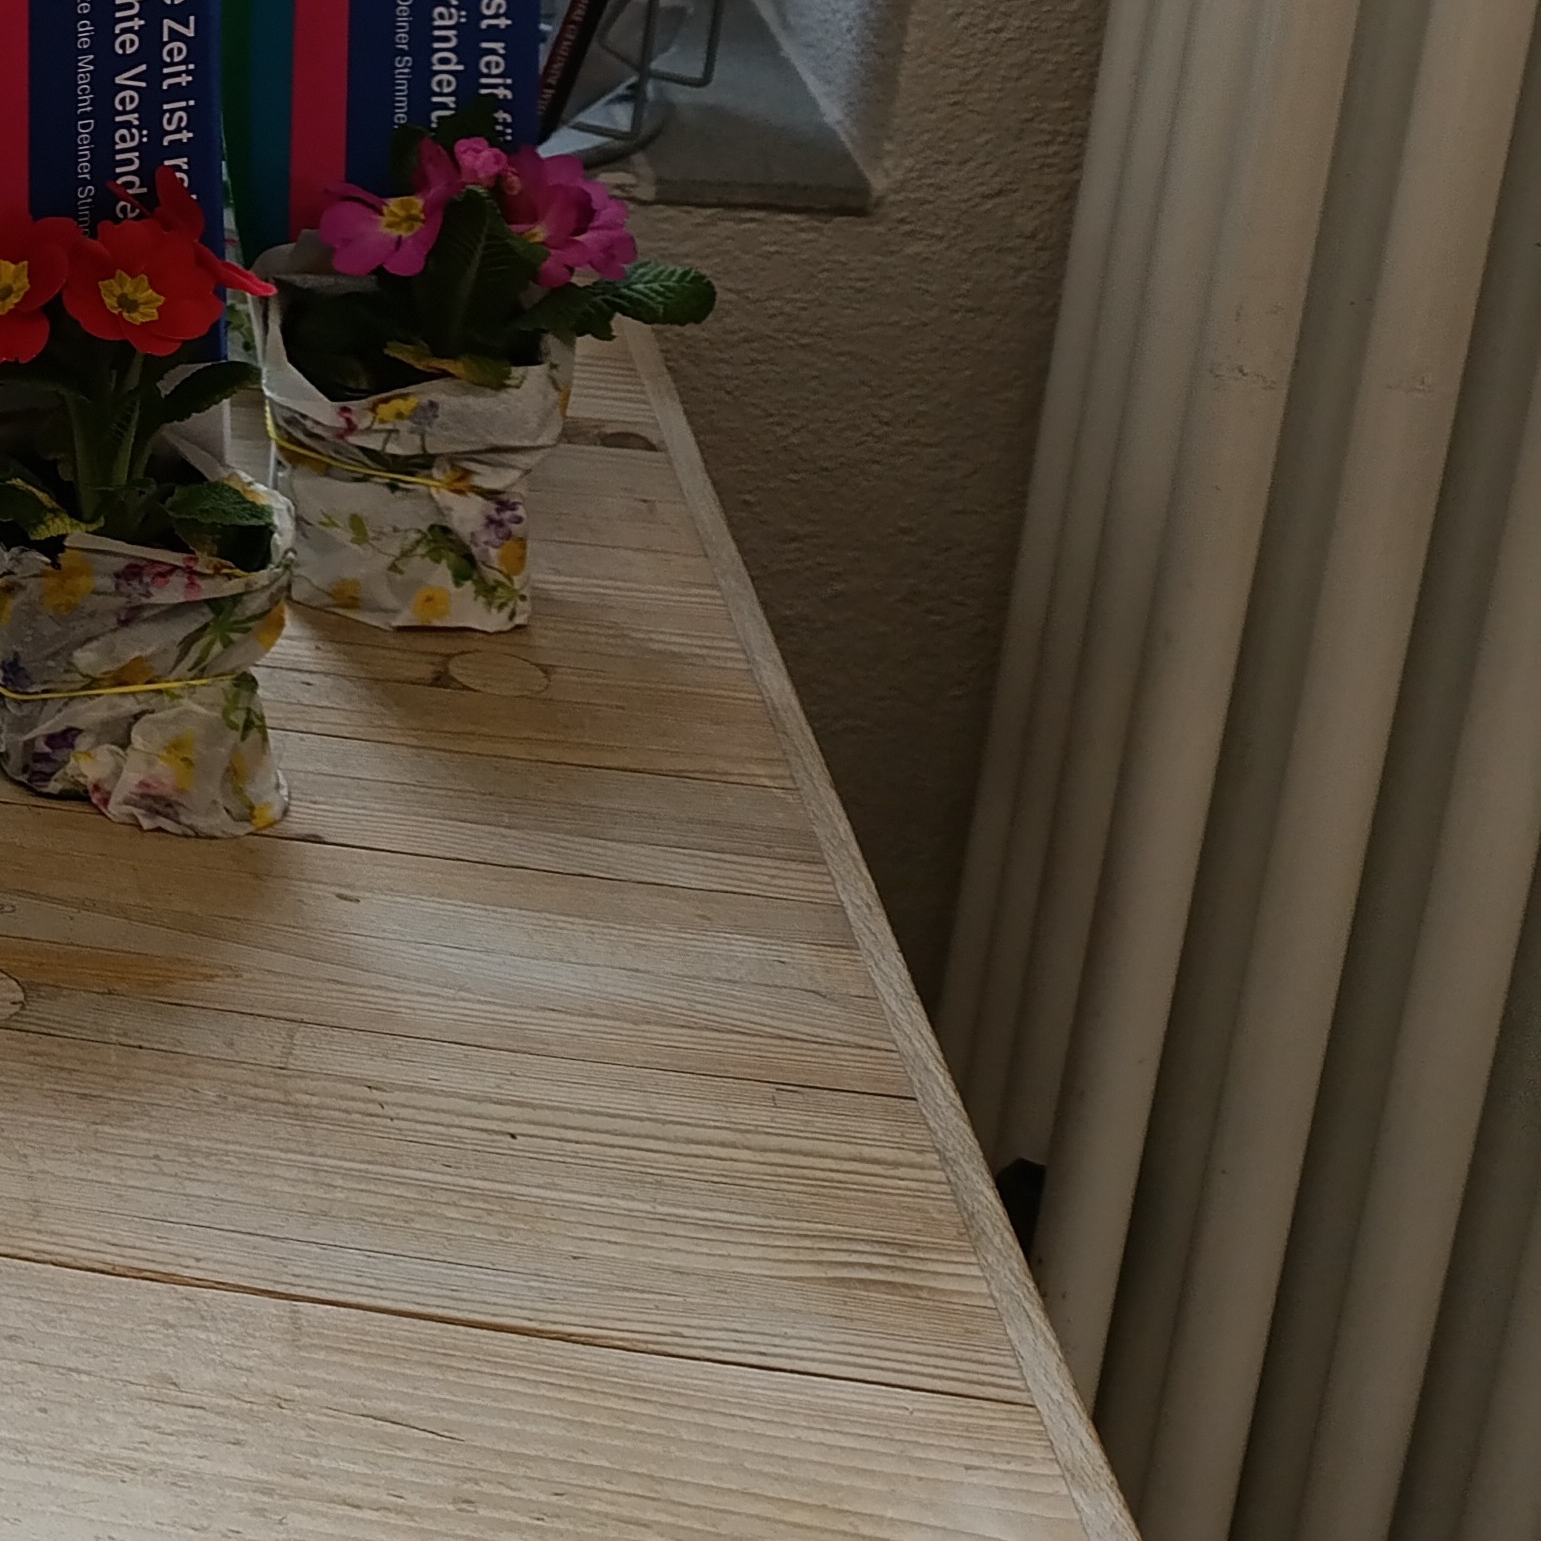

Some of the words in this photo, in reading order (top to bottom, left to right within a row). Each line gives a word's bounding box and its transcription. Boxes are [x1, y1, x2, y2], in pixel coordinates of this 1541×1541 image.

[77, 20, 95, 49] die
[162, 15, 195, 90] Zeit
[77, 55, 95, 114] Macht
[479, 41, 513, 99] reif
[77, 119, 95, 180] Deiner
[162, 99, 195, 146] ist
